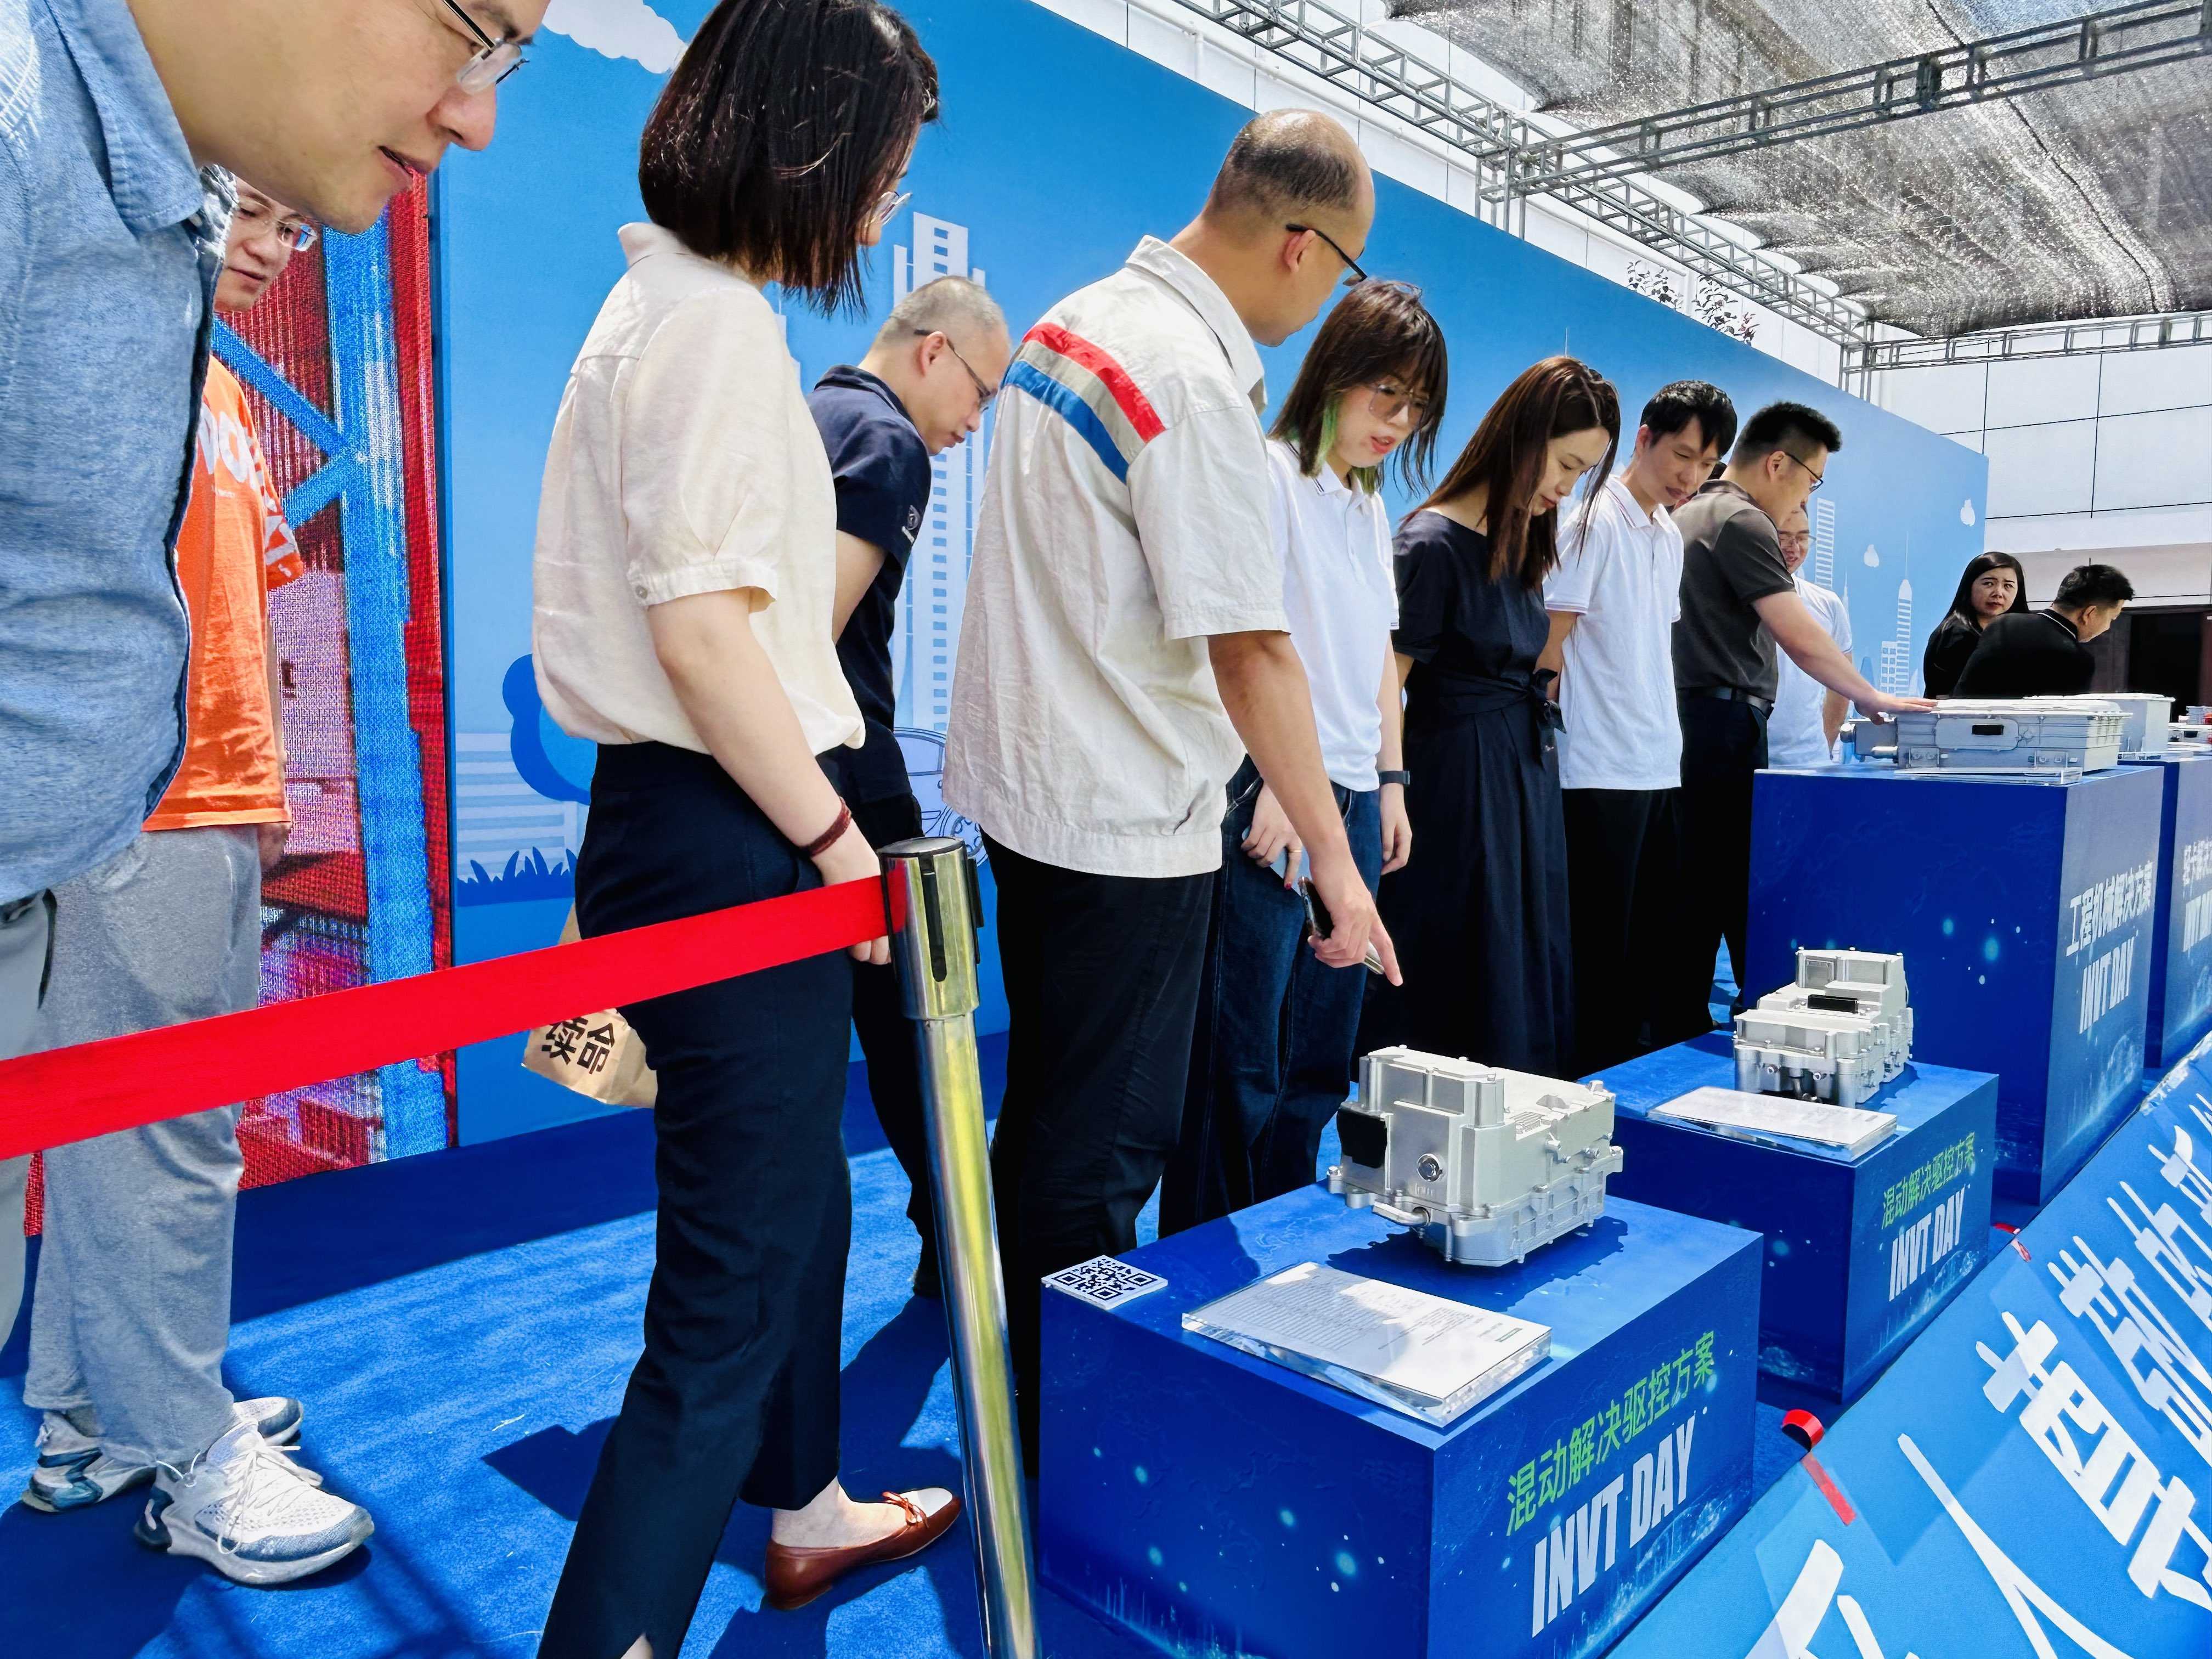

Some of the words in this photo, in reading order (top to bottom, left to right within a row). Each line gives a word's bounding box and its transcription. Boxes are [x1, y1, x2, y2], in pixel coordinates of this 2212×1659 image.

[2080, 955, 2112, 1034] INVT
[2109, 937, 2135, 1009] DAY
[542, 1017, 614, 1074] 续命
[1882, 1132, 1975, 1229] 混动解决驱控方案
[1889, 1212, 1932, 1302] INVT
[1933, 1186, 1966, 1265] DAY
[1506, 1331, 1715, 1536] 混动解决驱控方案
[1532, 1474, 1624, 1638] INVT
[1630, 1415, 1696, 1548] DAY
